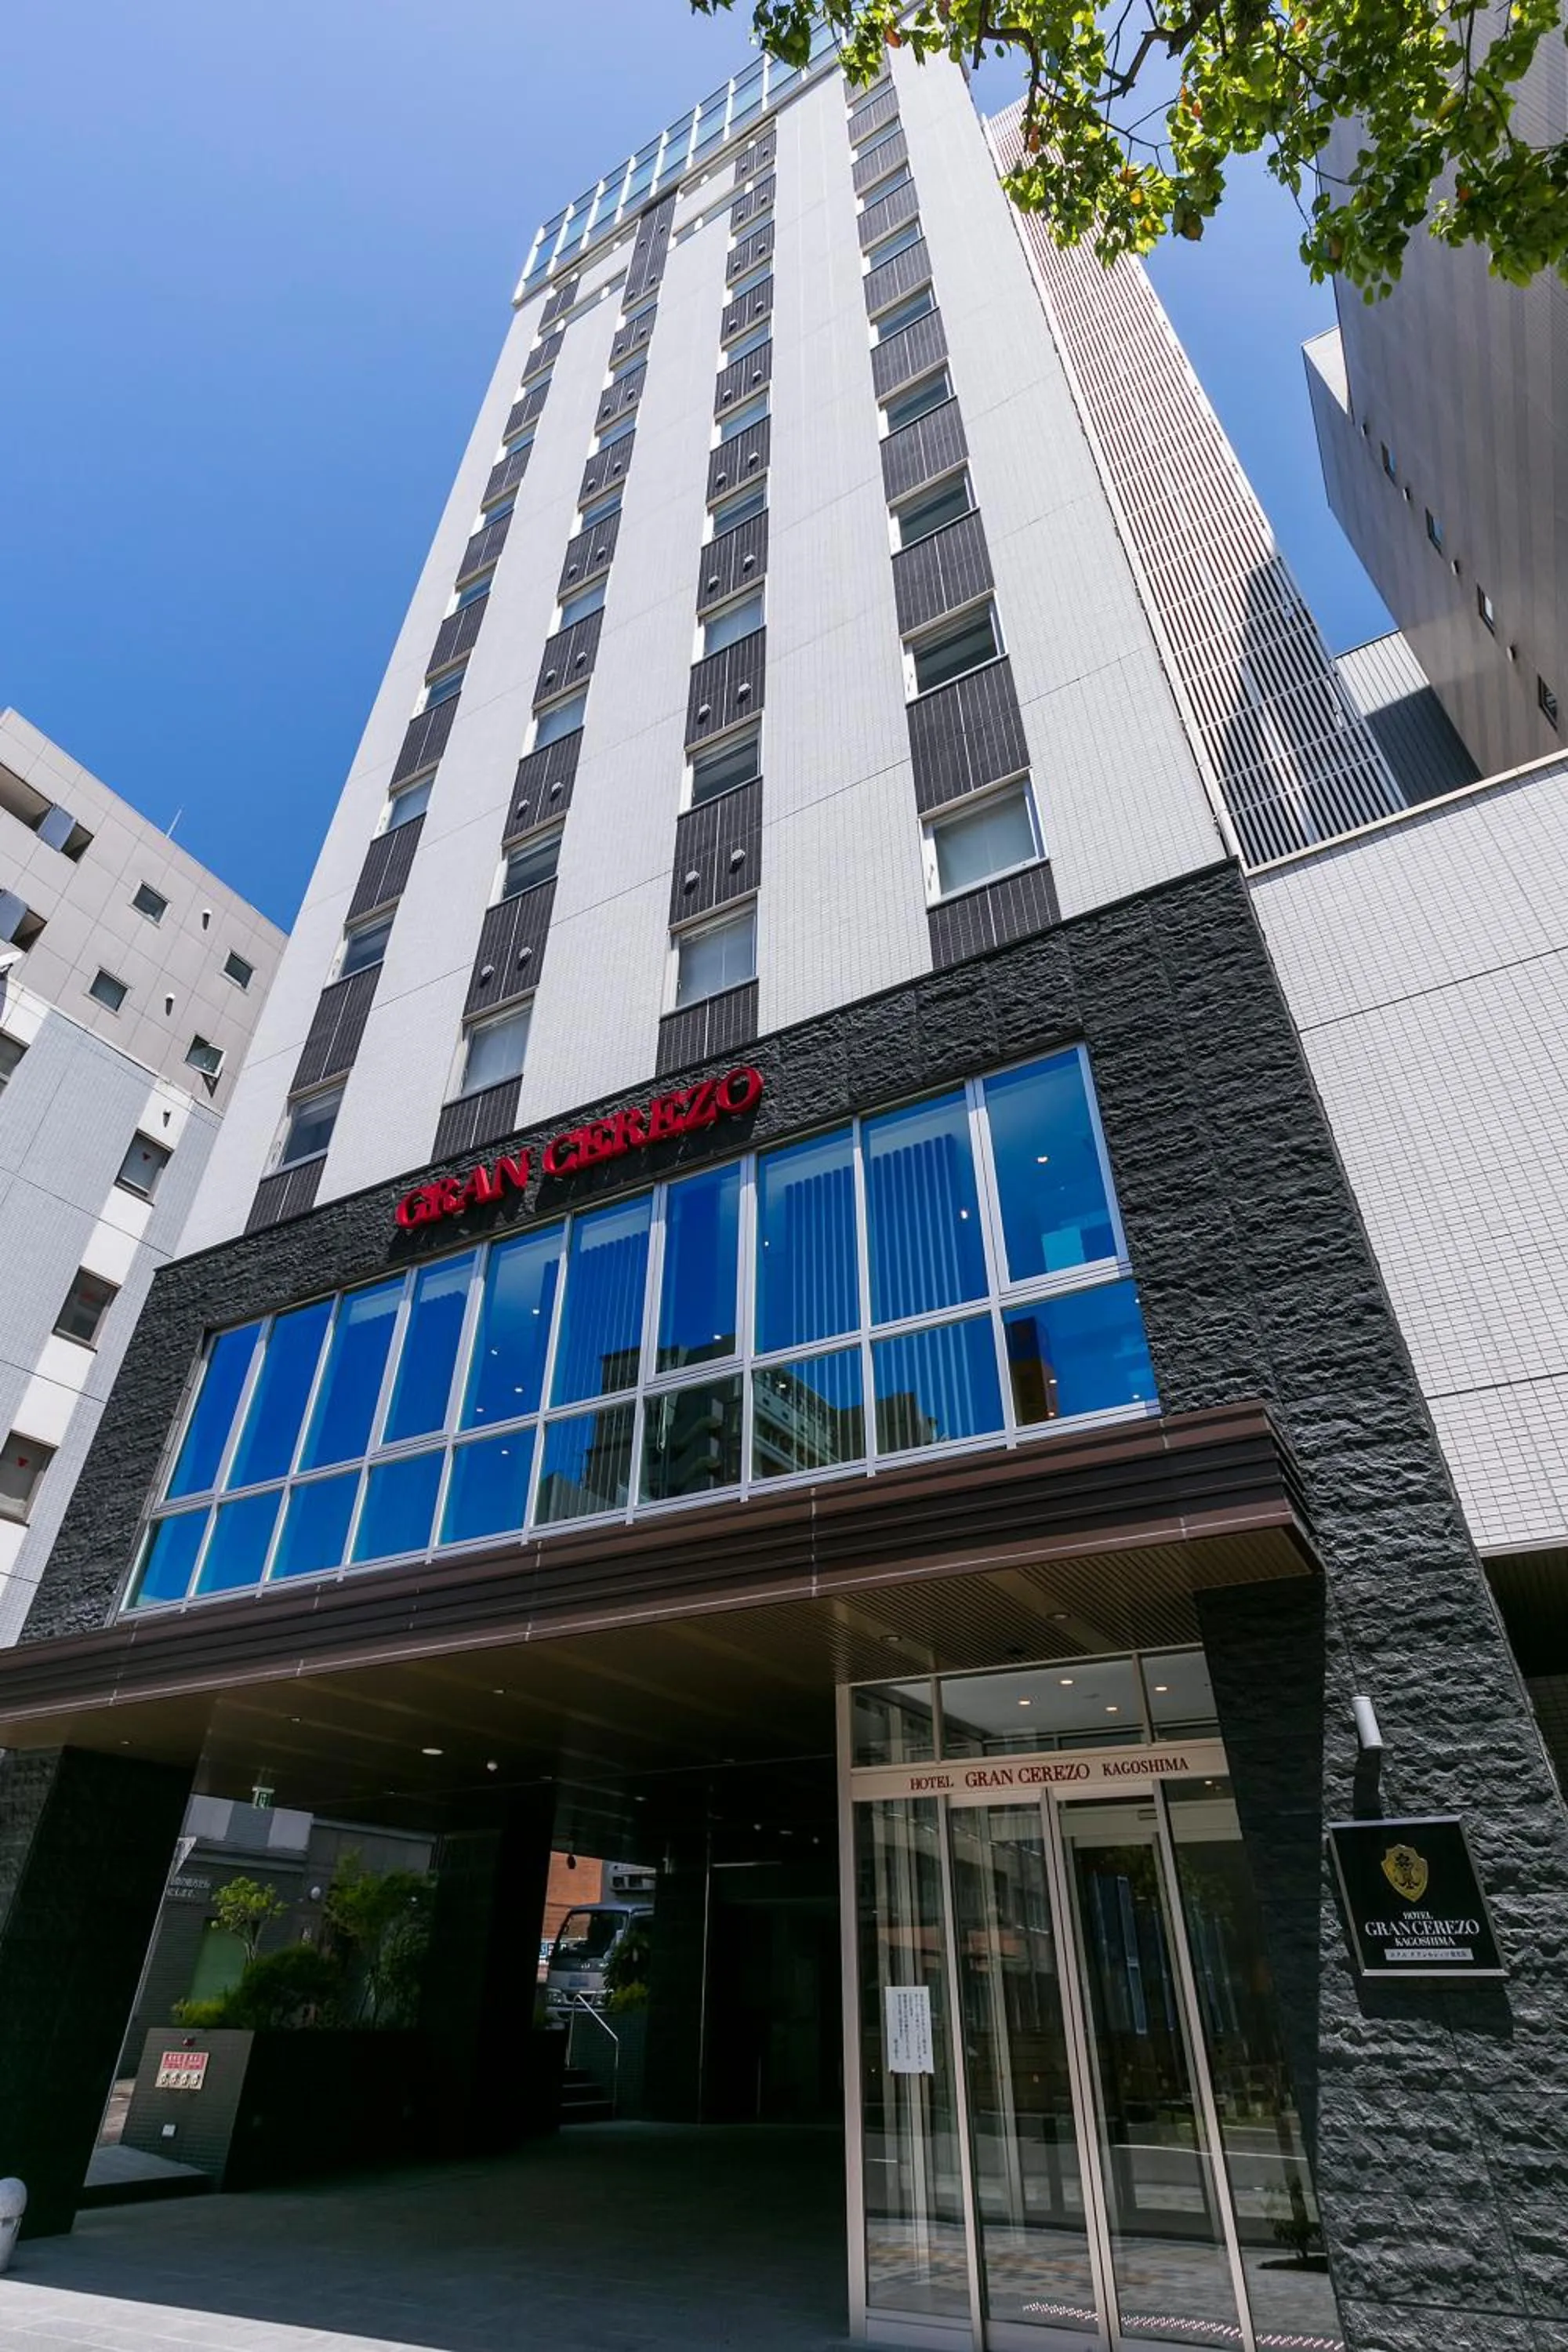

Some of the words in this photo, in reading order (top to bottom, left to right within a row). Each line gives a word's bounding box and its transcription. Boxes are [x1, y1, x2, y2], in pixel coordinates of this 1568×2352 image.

[395, 1147, 535, 1229] GRAN
[542, 1066, 764, 1175] CEREZO
[909, 1773, 954, 1790] HOTEL
[964, 1769, 1014, 1788] GRAN
[1018, 1763, 1091, 1784] CEREZO
[1102, 1757, 1189, 1776] KAGOSHIMA
[1365, 1920, 1411, 1936] GRAN
[1411, 1918, 1480, 1936] CEREZO
[1395, 1936, 1457, 1947] KAGOSHIMA
